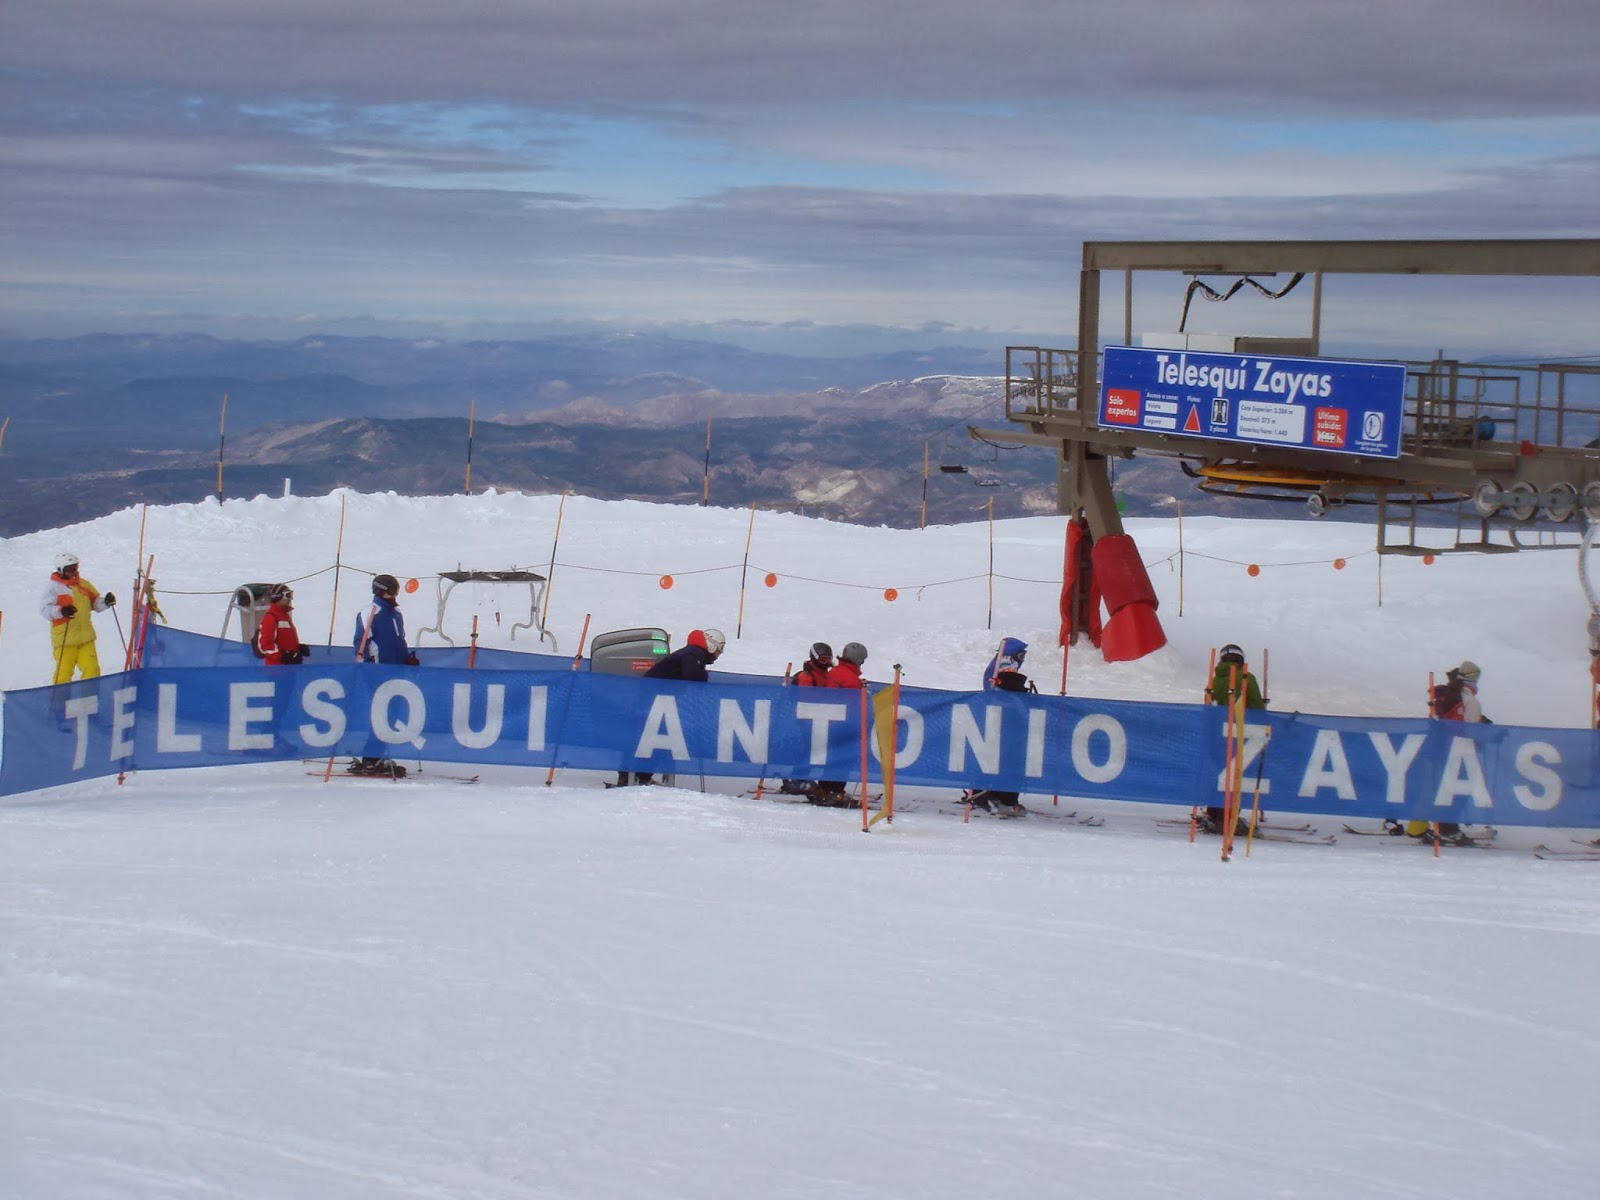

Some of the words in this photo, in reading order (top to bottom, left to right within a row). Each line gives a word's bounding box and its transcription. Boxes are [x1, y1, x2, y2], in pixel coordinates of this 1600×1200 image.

[1157, 354, 1247, 397] Telesquí
[1253, 362, 1332, 403] Zayas
[1109, 395, 1123, 405] Sólo
[1107, 407, 1137, 417] expertos
[1318, 409, 1339, 420] Última
[1317, 421, 1341, 430] subida:
[65, 678, 548, 771] TELESQUI
[635, 695, 1127, 783] ANTONIO
[1217, 722, 1563, 811] ZAYAS
